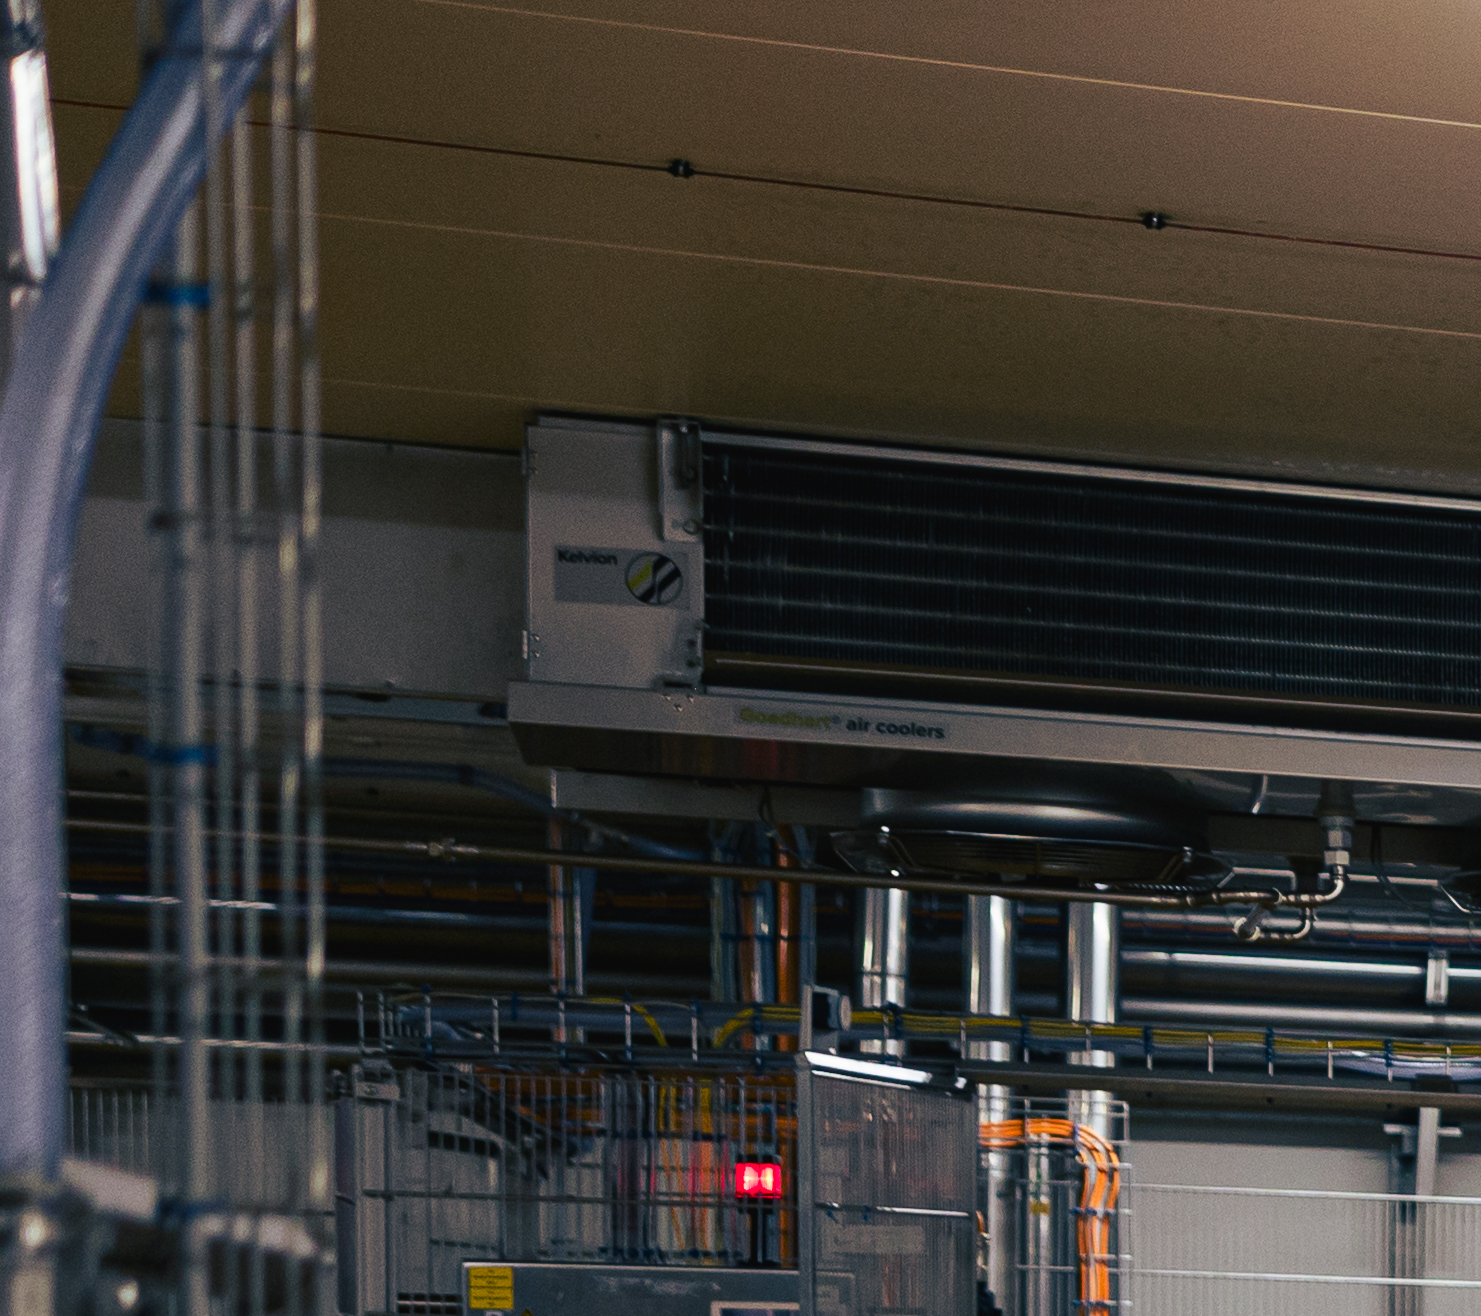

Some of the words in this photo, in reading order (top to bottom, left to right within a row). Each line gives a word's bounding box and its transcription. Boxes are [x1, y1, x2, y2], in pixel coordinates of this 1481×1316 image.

[558, 549, 619, 567] Kelvion
[846, 717, 871, 732] air
[876, 721, 946, 740] coolers
